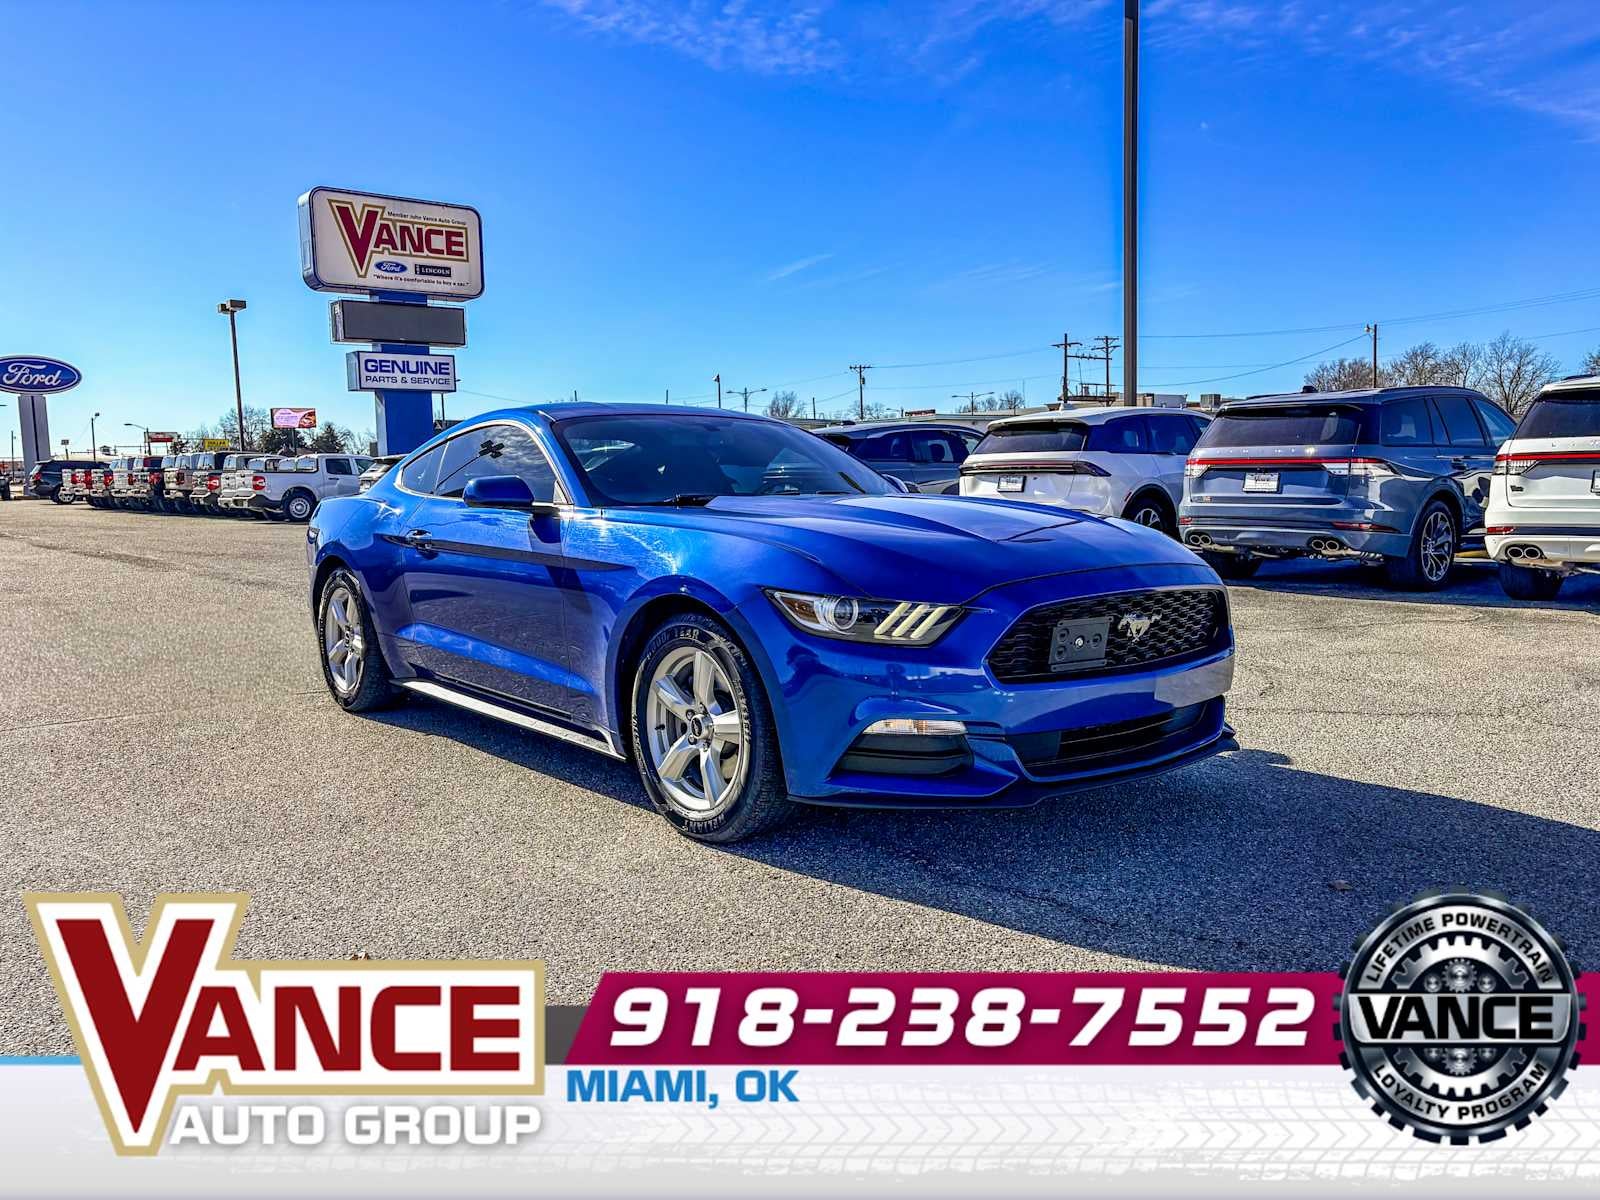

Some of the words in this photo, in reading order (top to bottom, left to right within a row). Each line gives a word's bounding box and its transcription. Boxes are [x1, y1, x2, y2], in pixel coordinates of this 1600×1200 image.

[335, 205, 465, 273] VANCE
[380, 261, 402, 272] Ford
[421, 267, 451, 275] LINCOLN
[3, 362, 62, 386] Ford
[364, 358, 450, 376] GENUINE
[365, 375, 398, 384] PARTS
[401, 376, 408, 384] &
[410, 377, 451, 385] SERVICE
